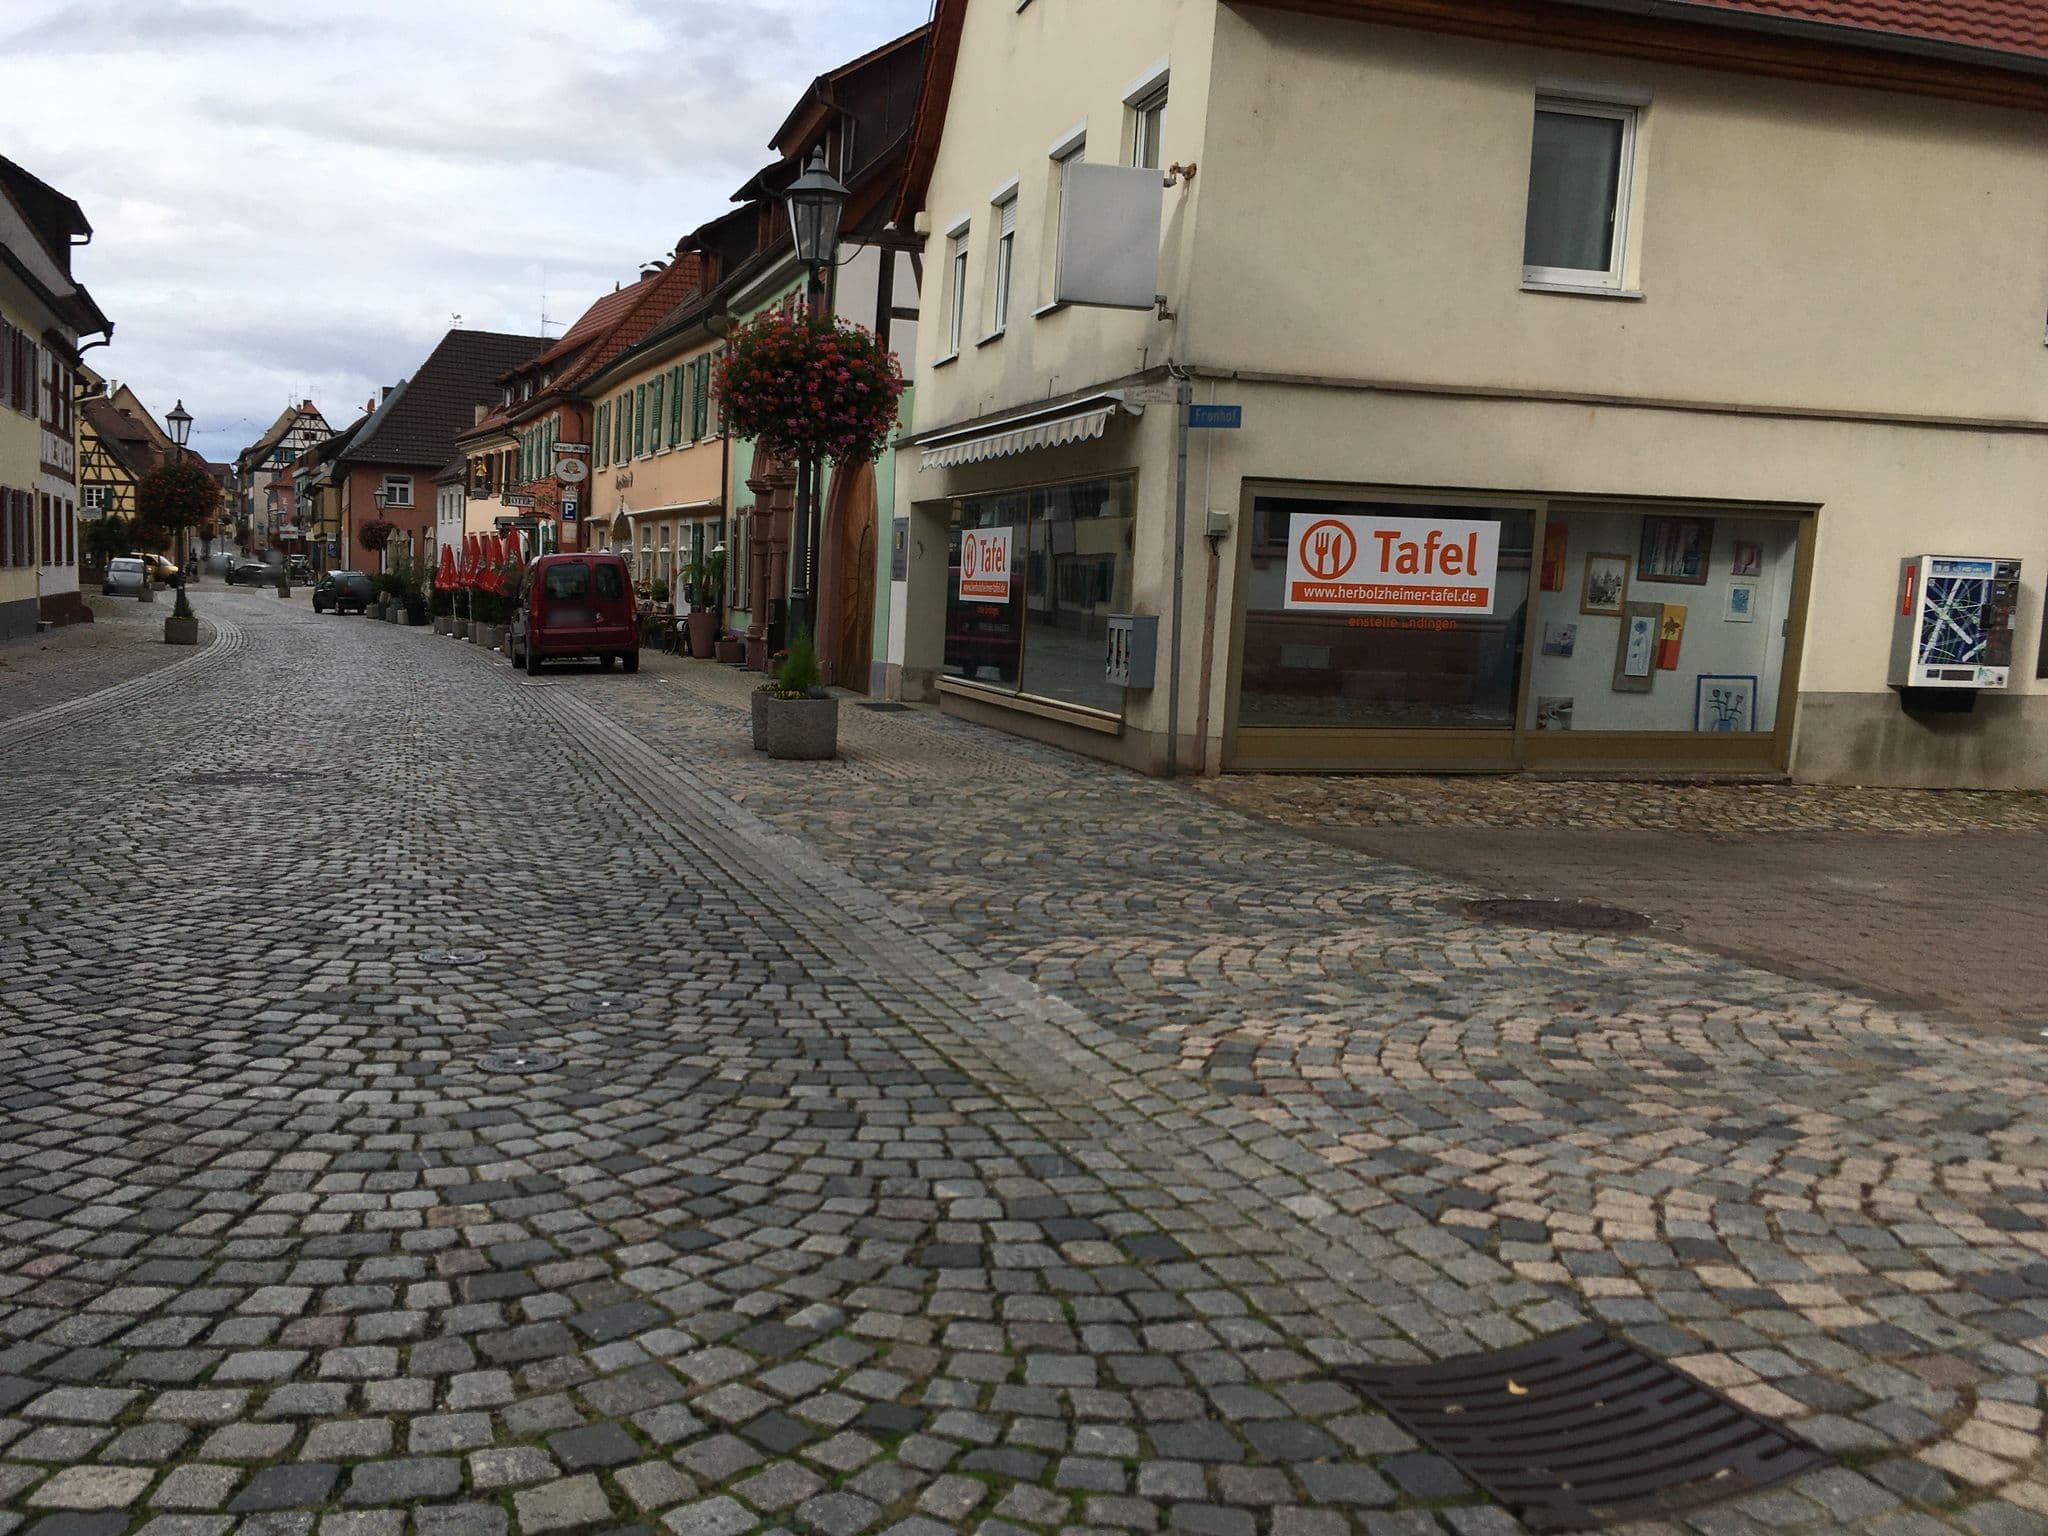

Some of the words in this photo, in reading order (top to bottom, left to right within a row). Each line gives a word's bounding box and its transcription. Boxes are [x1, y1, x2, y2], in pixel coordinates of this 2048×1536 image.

[565, 503, 574, 514] P
[980, 537, 1007, 573] Tafel
[1374, 530, 1478, 576] Tafel
[1304, 586, 1477, 603] www.herbolzheimer-tafel.de
